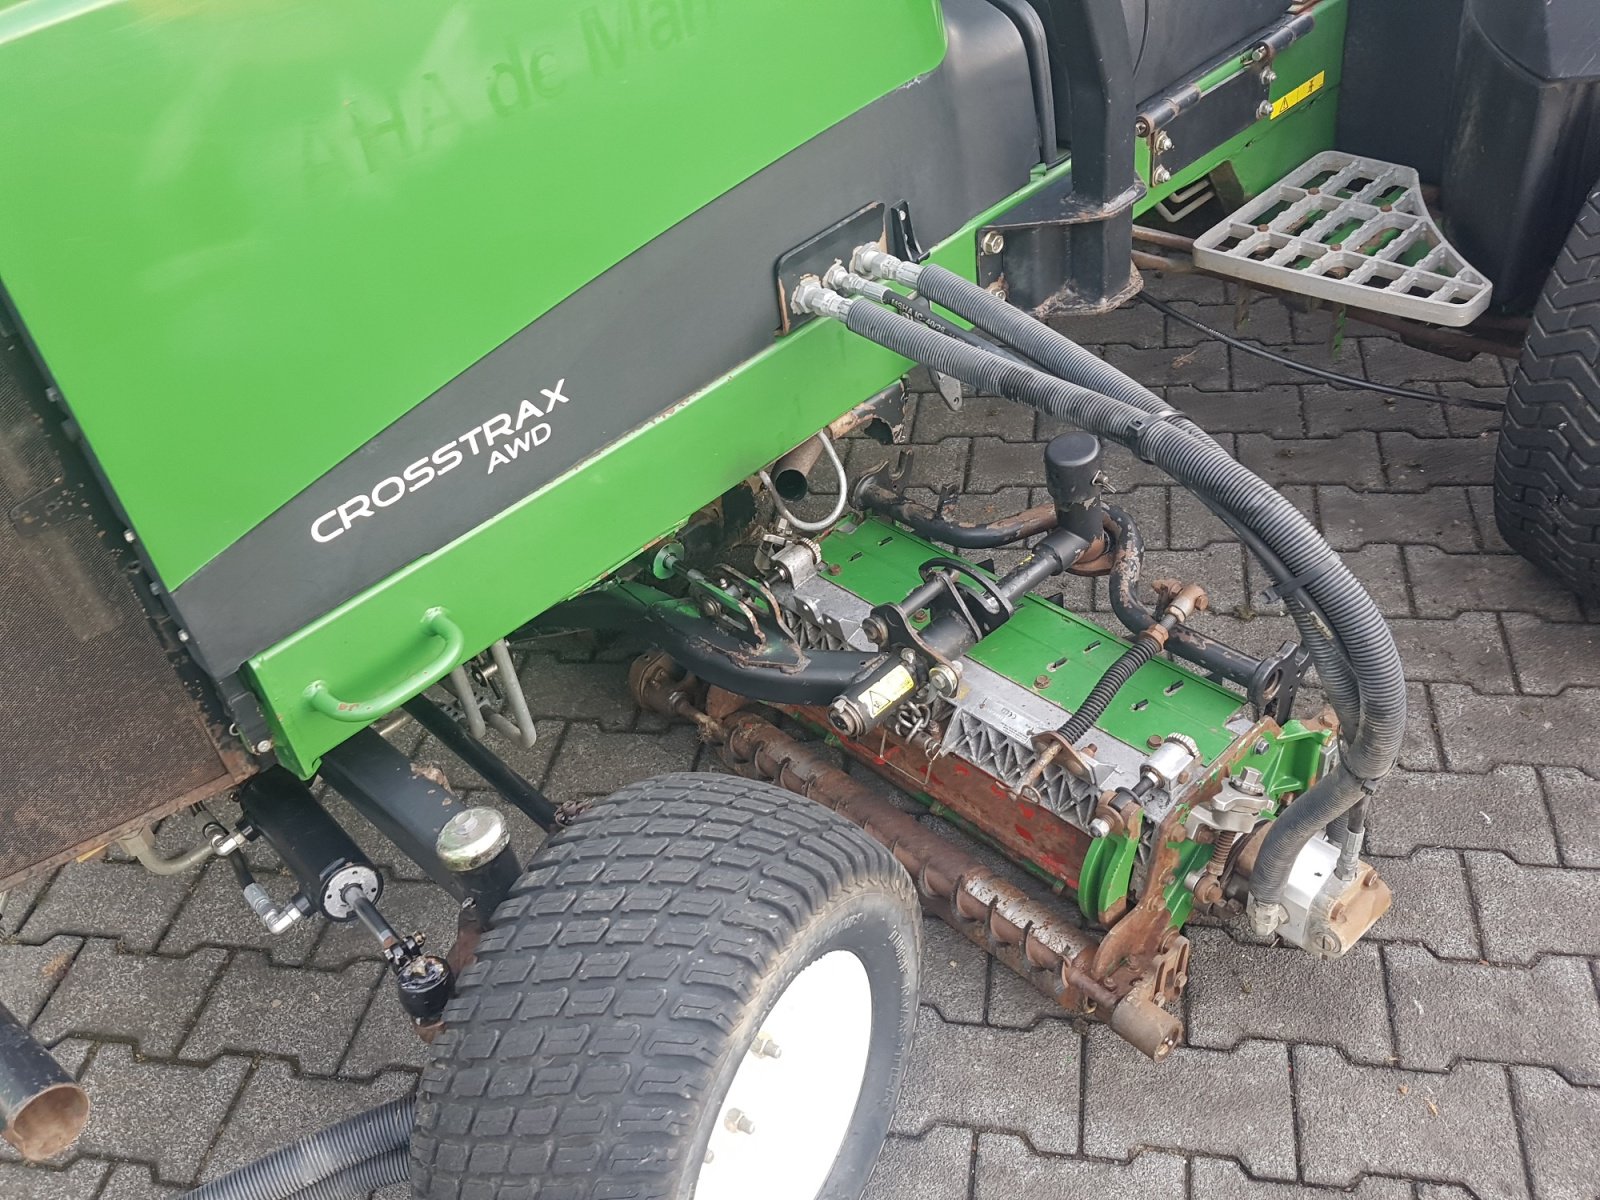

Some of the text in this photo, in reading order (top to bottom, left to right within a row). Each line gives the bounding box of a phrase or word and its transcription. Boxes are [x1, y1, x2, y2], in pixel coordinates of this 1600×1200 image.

[486, 34, 567, 118] de
[310, 378, 570, 543] CROSSTRAX
[487, 422, 552, 475] AWD
